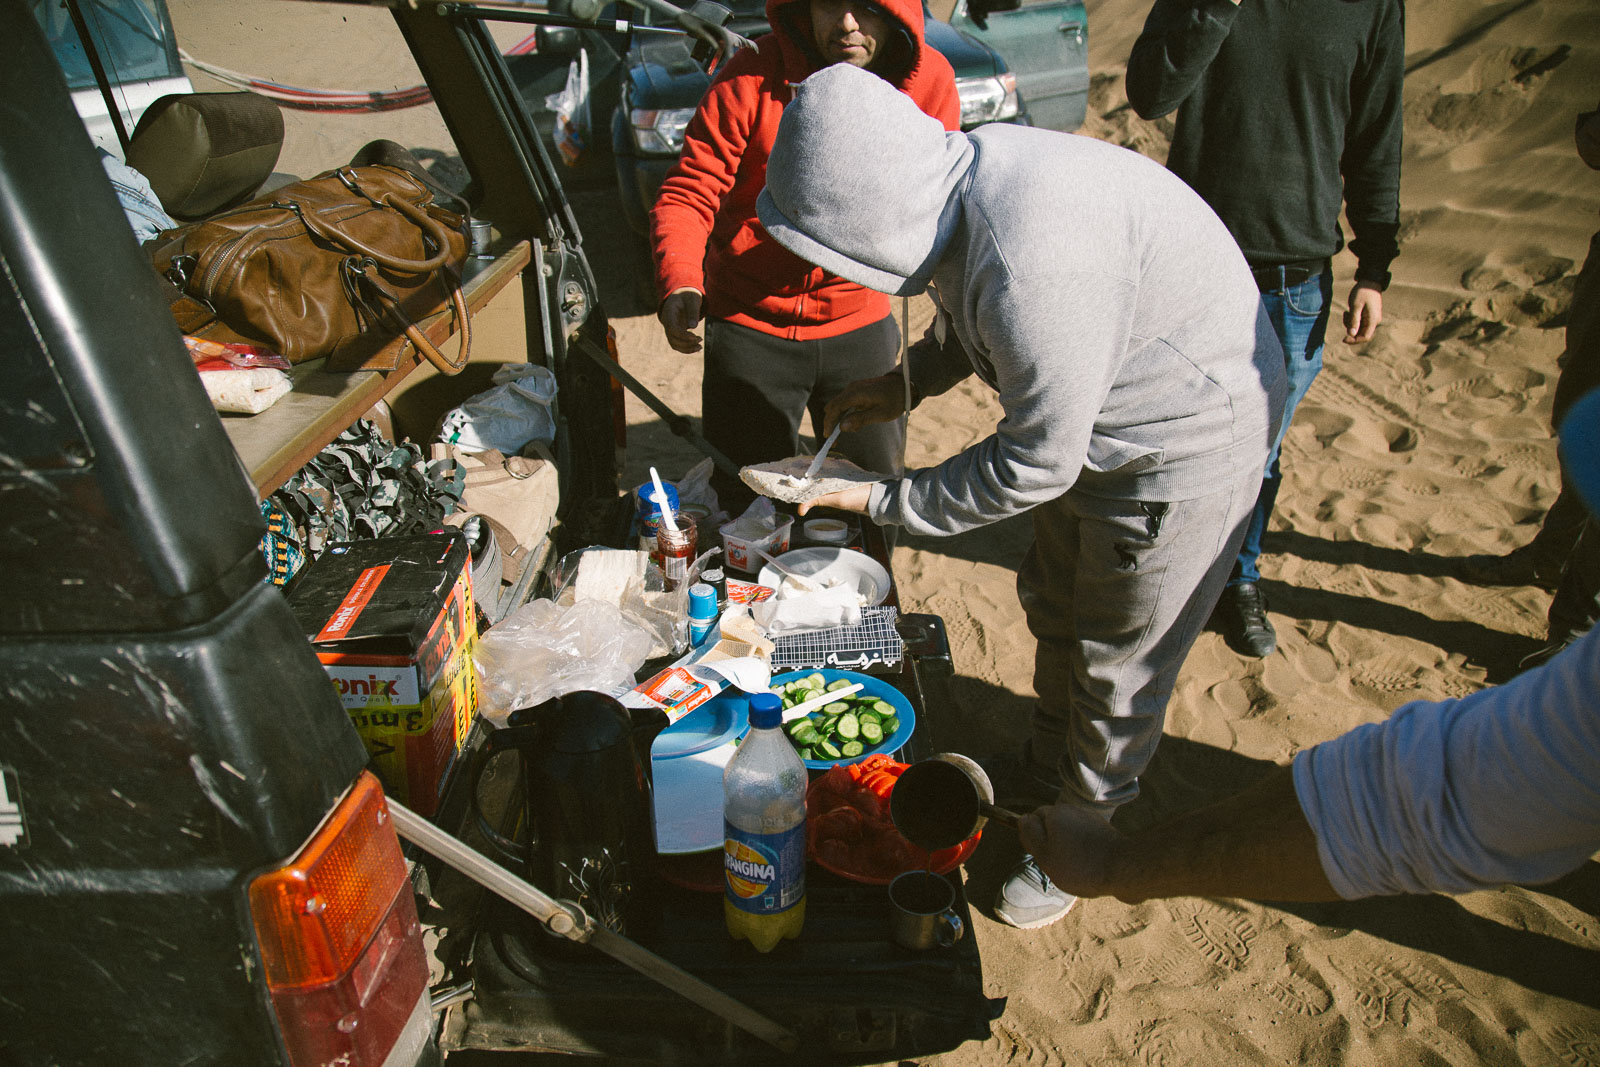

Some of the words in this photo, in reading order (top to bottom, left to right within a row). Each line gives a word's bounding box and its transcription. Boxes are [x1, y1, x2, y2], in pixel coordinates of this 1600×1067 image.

[325, 606, 358, 633] Ronix
[331, 674, 400, 696] onix
[725, 852, 776, 881] RANGINA
